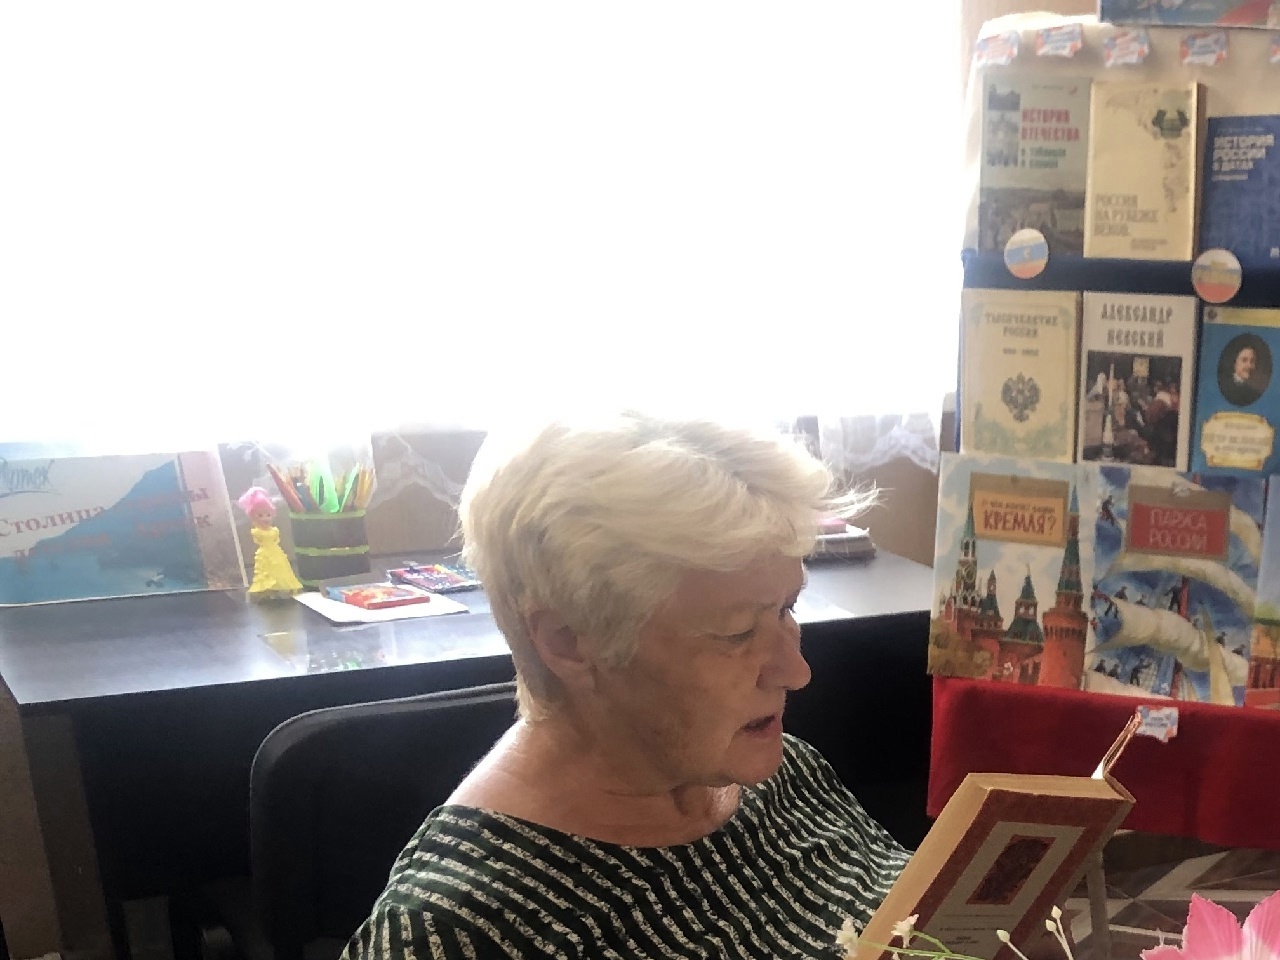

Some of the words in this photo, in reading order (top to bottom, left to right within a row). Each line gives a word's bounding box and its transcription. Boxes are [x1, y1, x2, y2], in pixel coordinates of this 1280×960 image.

[1101, 302, 1174, 325] АЛЕКСАНДР
[1107, 328, 1165, 348] НЕВСКИЙ
[983, 510, 1057, 535] КРЕМЛЯ?
